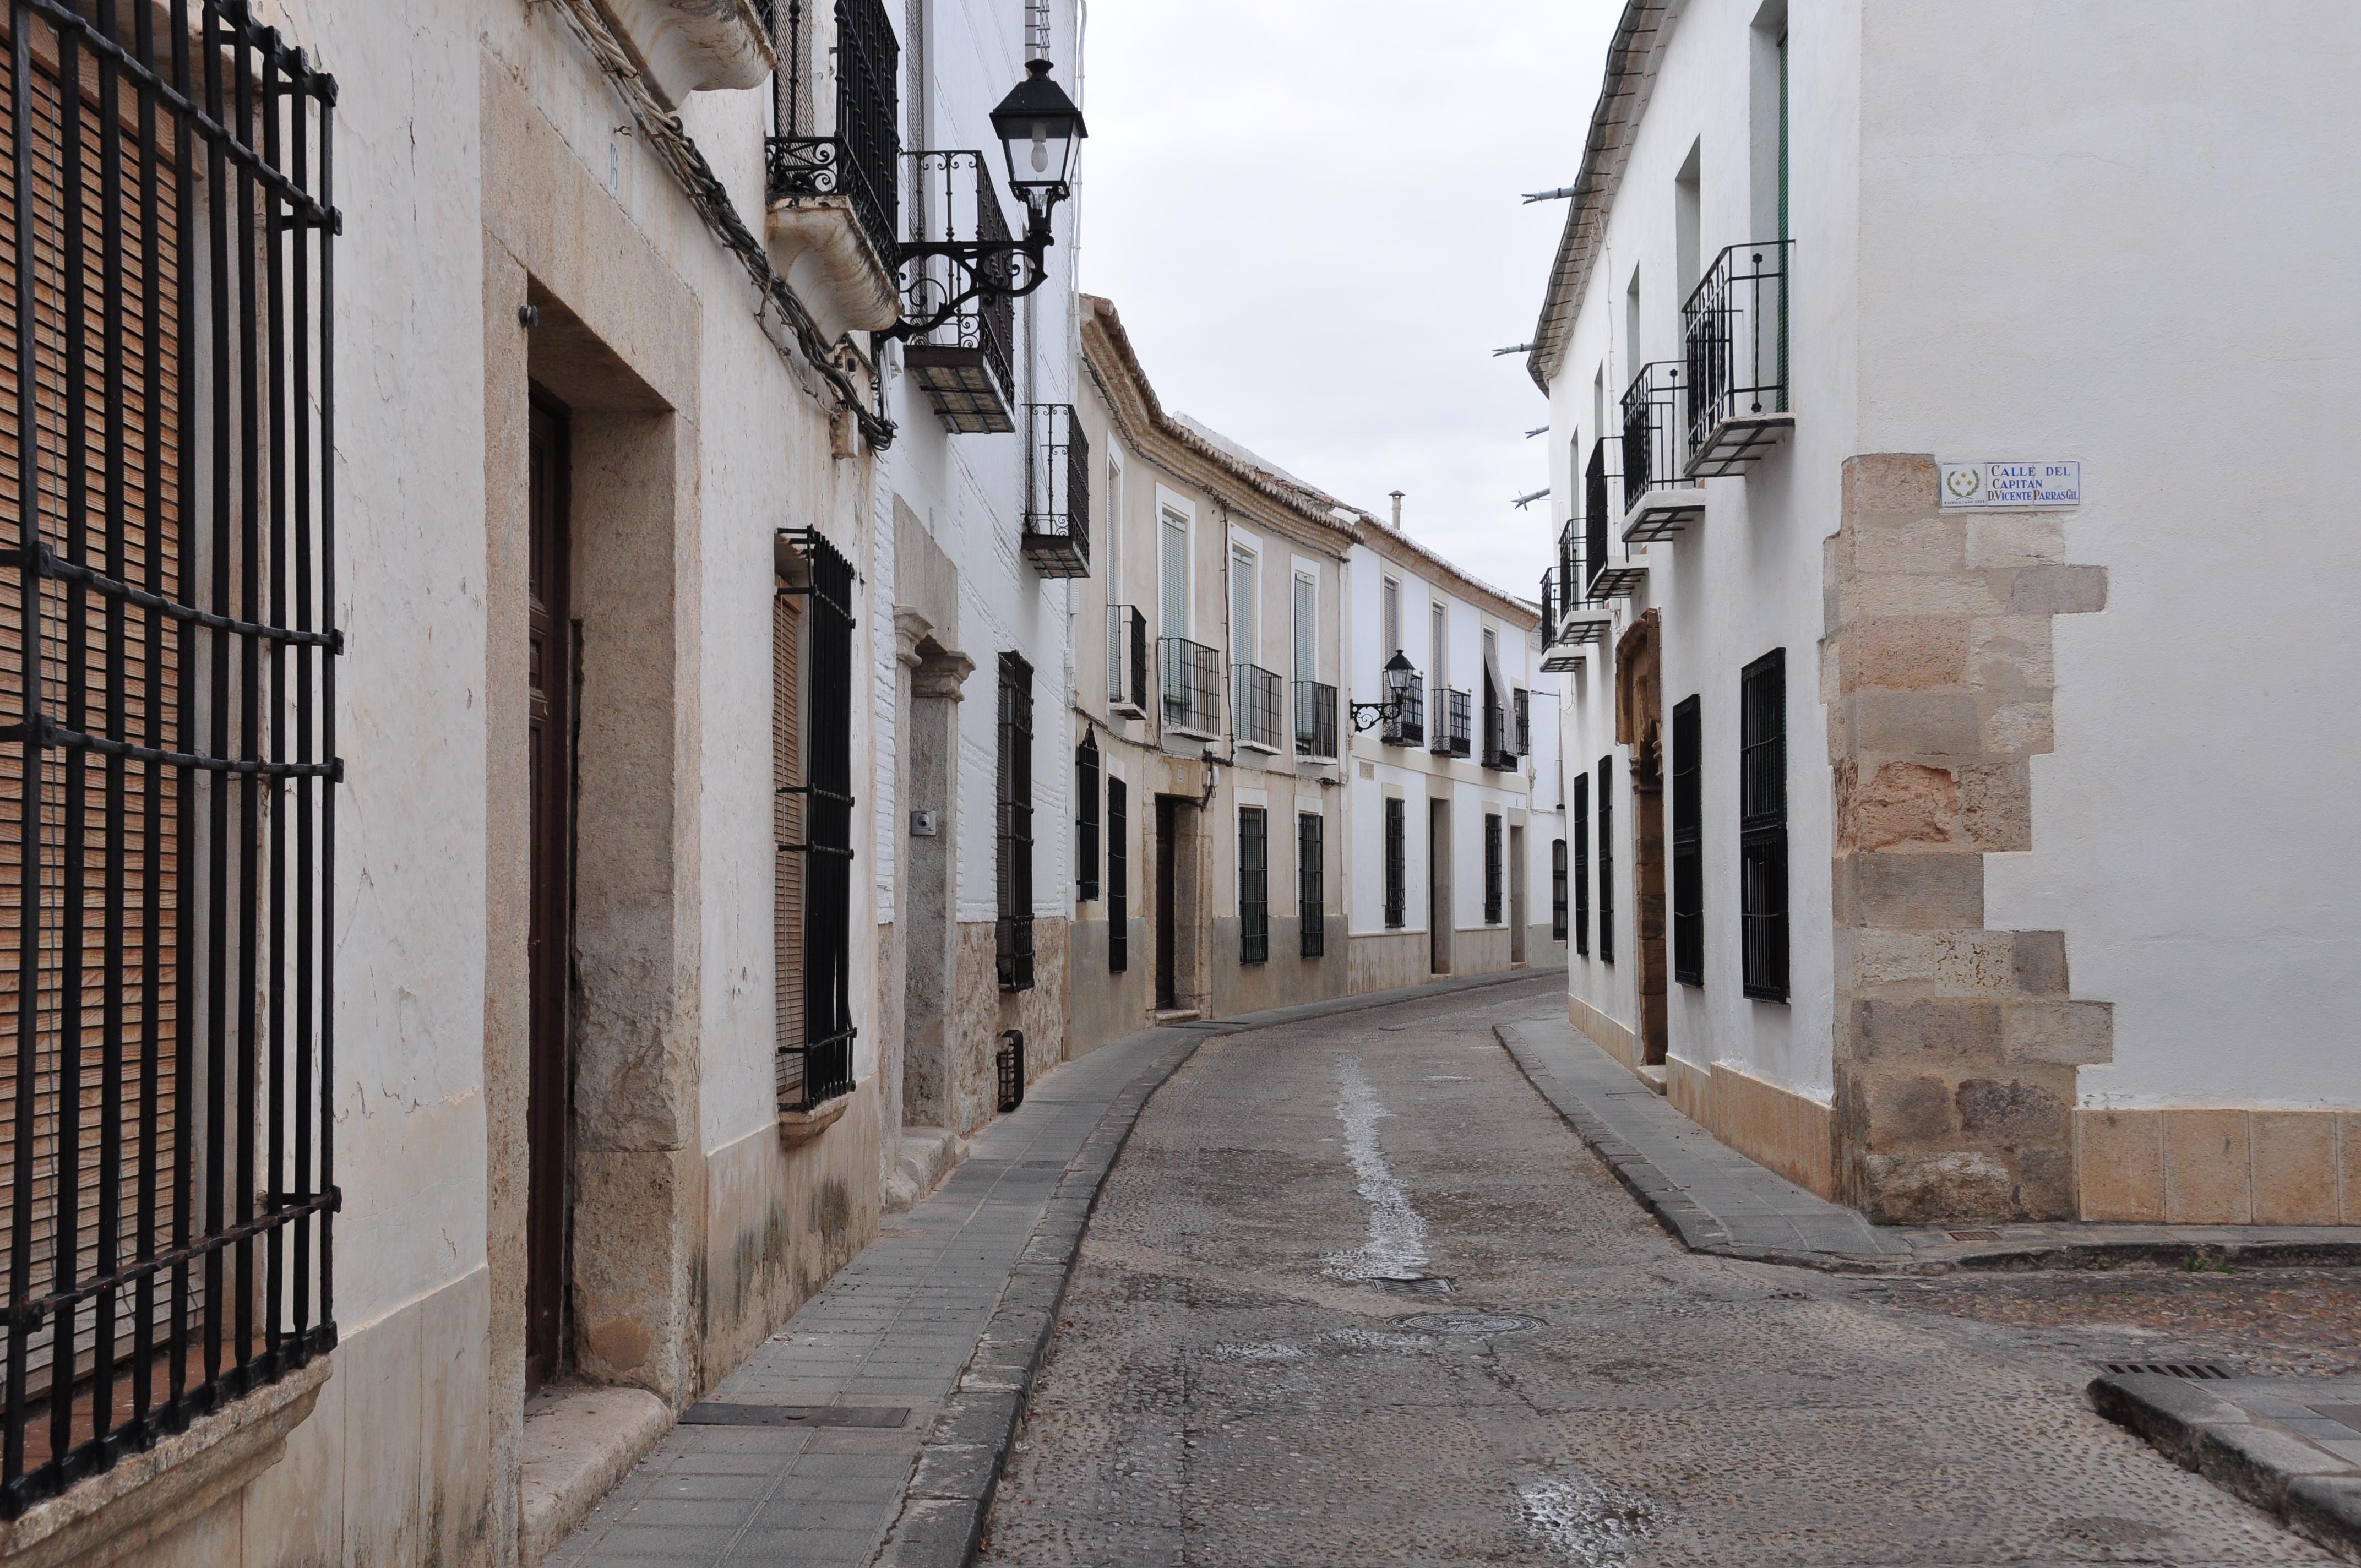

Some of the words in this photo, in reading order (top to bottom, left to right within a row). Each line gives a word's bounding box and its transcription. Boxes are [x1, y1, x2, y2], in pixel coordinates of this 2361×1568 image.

[610, 143, 618, 190] 16
[1991, 465, 2036, 477] CALLE
[2046, 466, 2071, 476] DEL
[1992, 478, 2043, 489] CAPITAN
